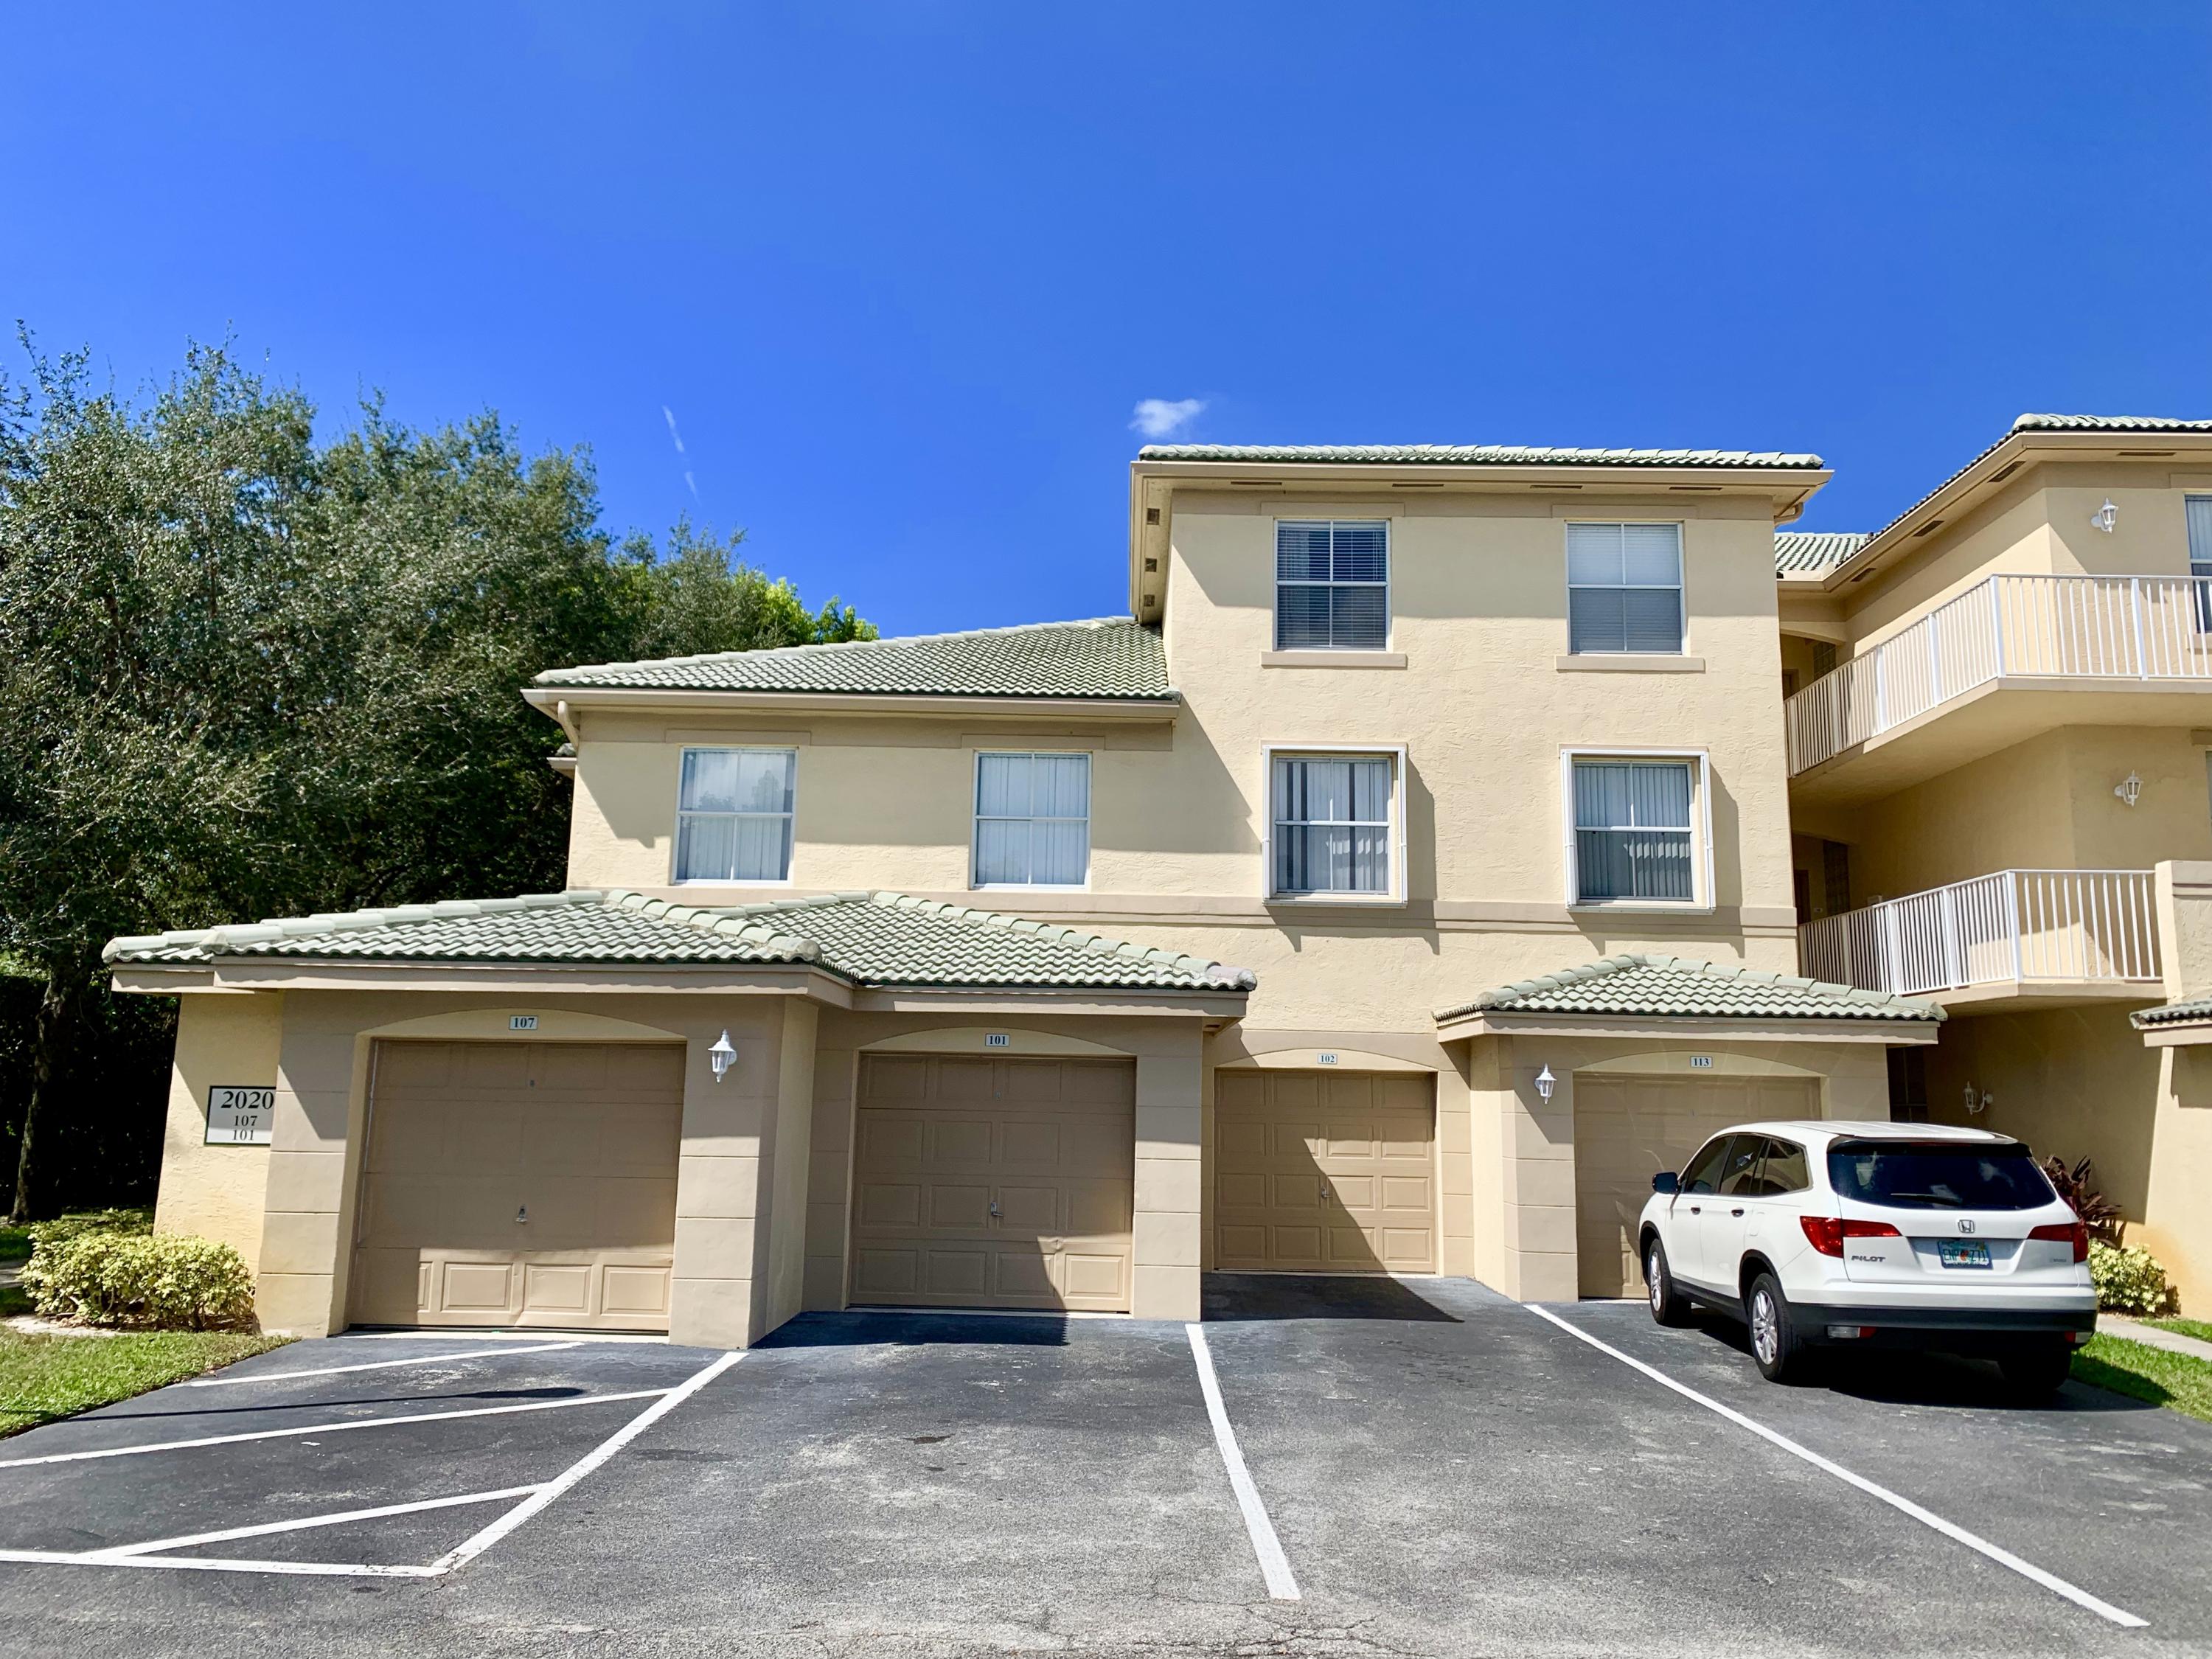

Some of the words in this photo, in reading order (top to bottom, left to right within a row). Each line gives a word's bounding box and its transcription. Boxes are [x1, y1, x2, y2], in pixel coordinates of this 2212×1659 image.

[515, 1018, 535, 1028] 107
[990, 1036, 1006, 1045] 101
[1694, 1058, 1709, 1066] 113
[220, 1091, 274, 1110] 2020
[234, 1115, 258, 1127] 107
[232, 1129, 254, 1141] 101
